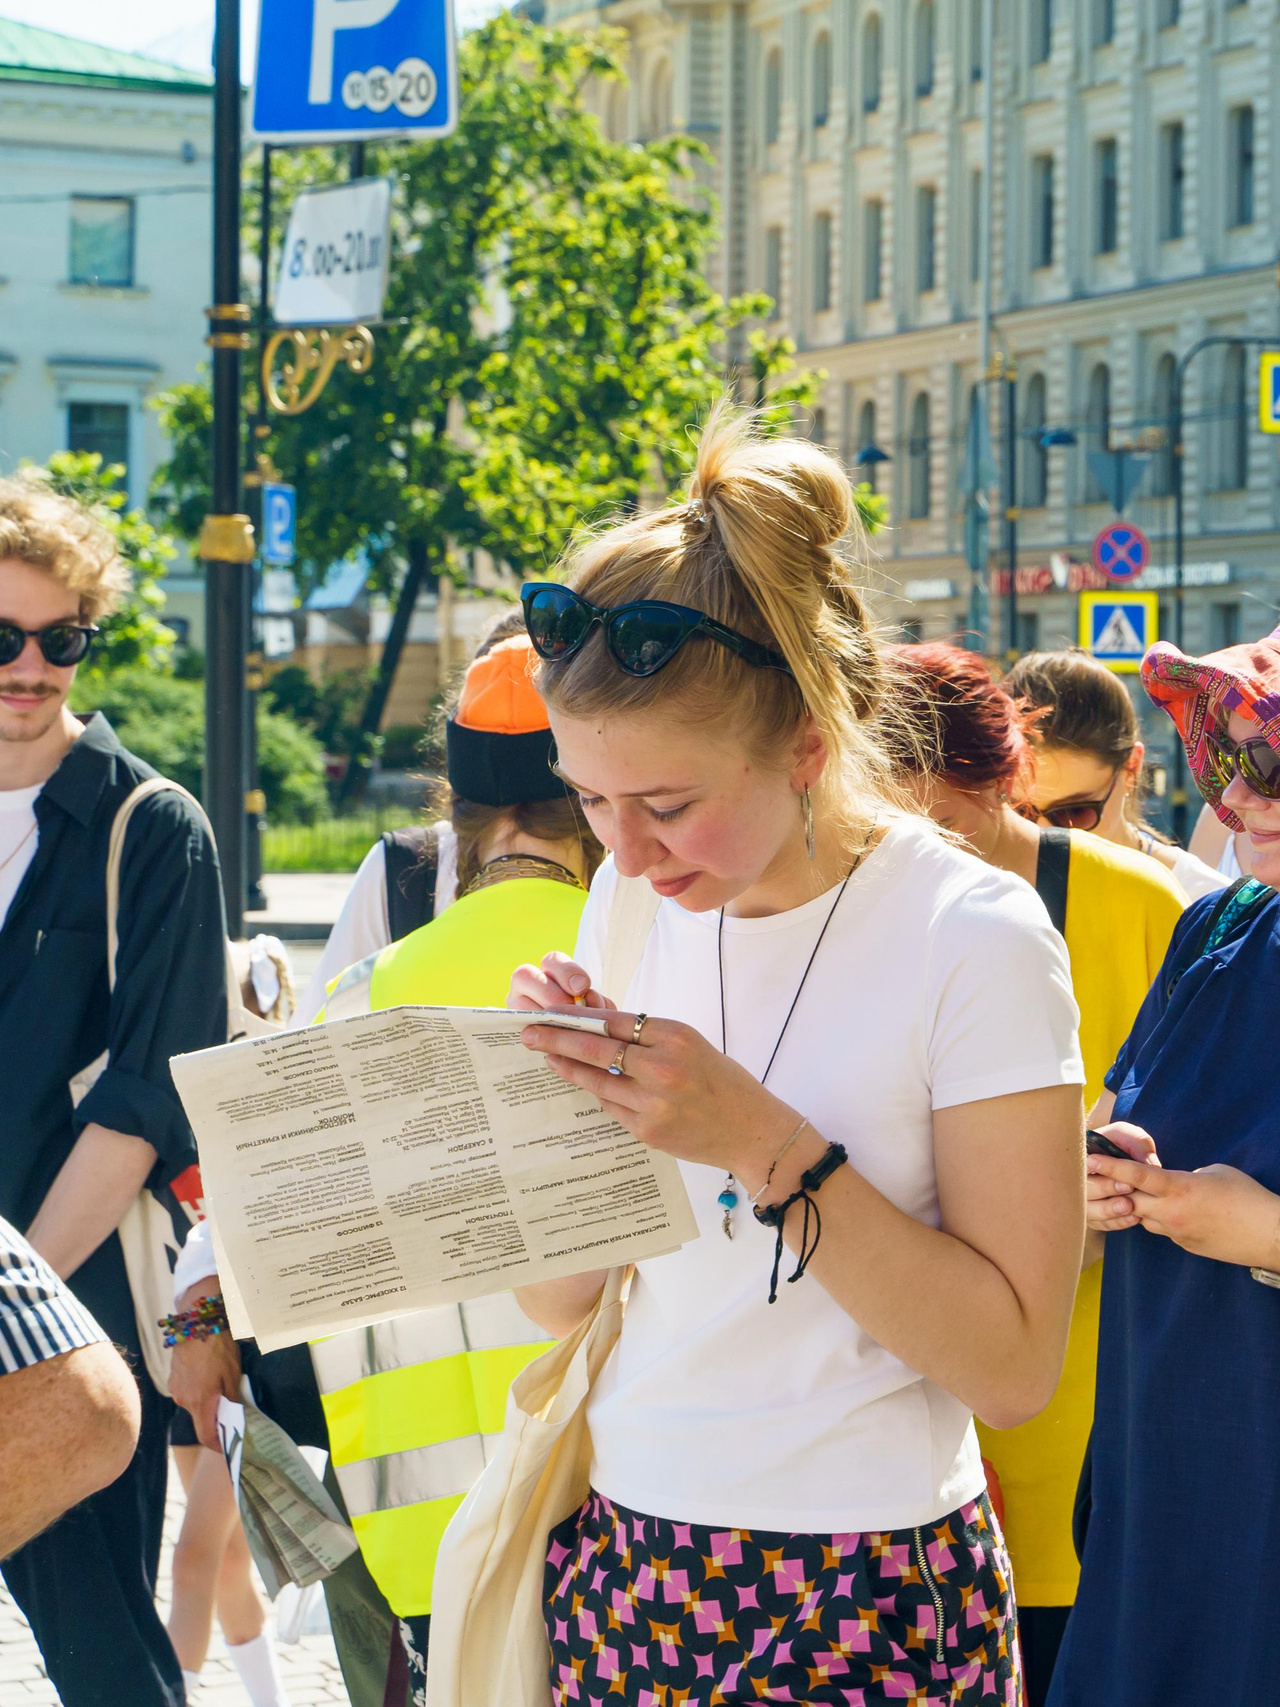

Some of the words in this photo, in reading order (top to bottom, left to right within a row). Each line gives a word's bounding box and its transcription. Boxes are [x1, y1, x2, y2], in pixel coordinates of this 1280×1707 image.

[308, 0, 401, 104] P
[399, 72, 432, 103] 20
[313, 1064, 338, 1073] НАЧАЛО
[574, 1107, 598, 1118] ЧИТКА
[287, 1118, 347, 1138] БЕСПОКОЙНИКИ
[235, 1136, 280, 1151] КРИКЕТНЫЙ
[447, 1139, 485, 1153] САКЕРДОН
[610, 1160, 645, 1172] ВЫСТАВКА
[565, 1170, 610, 1183] ПОГРУЖЕНИЕ
[465, 1211, 508, 1224] ПОЧТАЛЬОН
[336, 1223, 374, 1237] ФИЛОСОФ
[632, 1223, 666, 1236] ВЫСТАВКА
[609, 1232, 631, 1242] МУЗЕЙ
[572, 1239, 608, 1251] МАРШРУТА
[543, 1248, 572, 1258] СТАРУХИ
